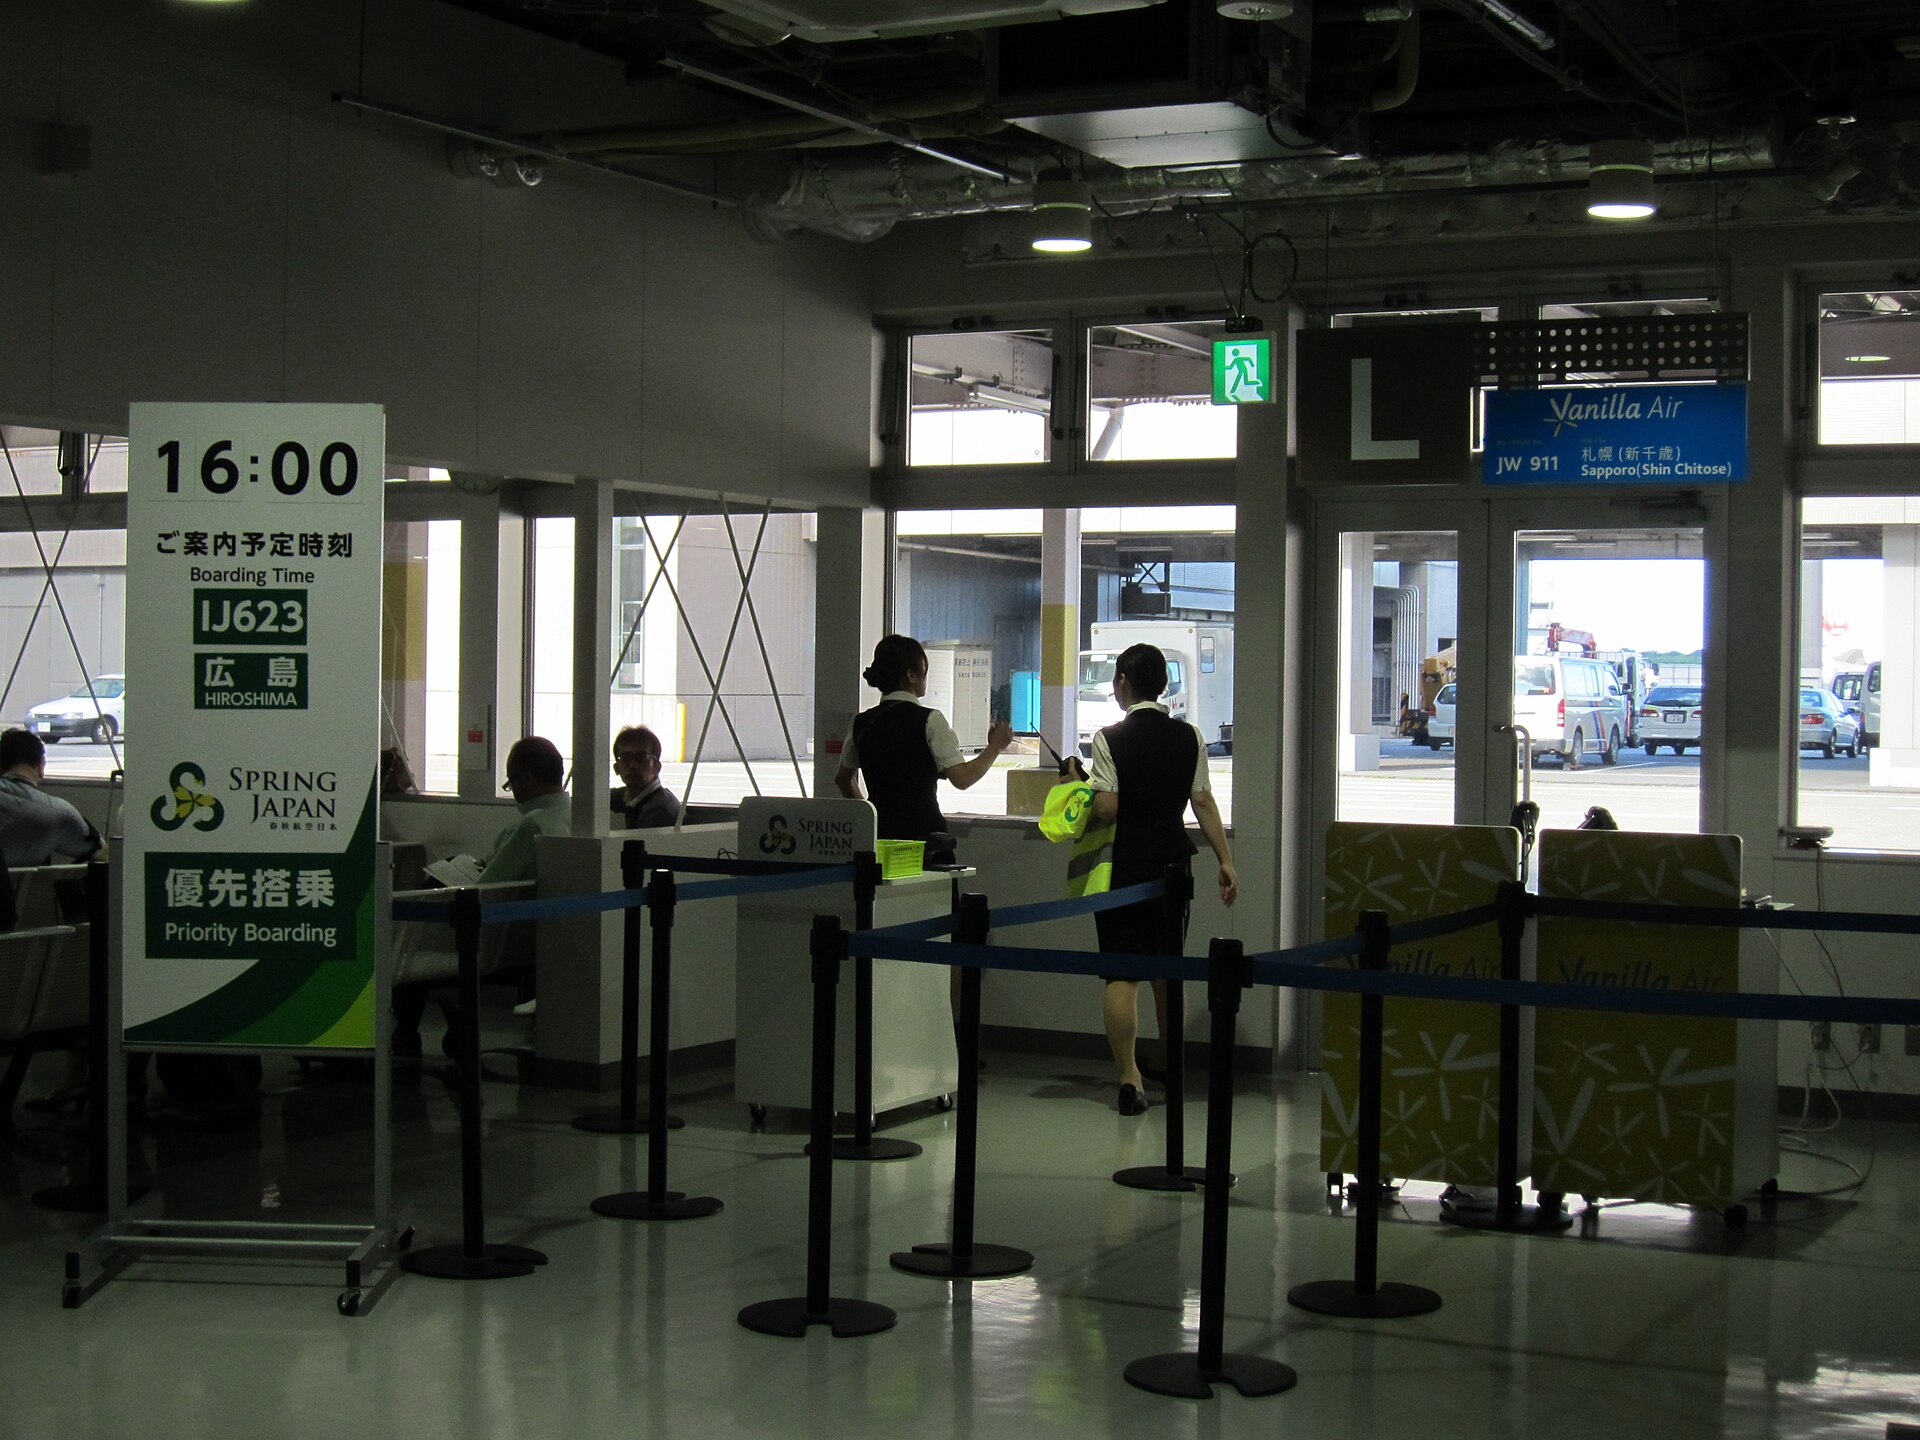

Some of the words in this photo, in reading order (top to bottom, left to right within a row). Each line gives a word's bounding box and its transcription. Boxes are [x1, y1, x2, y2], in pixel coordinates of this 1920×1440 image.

[1351, 358, 1420, 461] L
[1549, 392, 1641, 426] Vanilla
[1647, 396, 1683, 419] Air
[157, 440, 358, 496] 16:00
[1496, 456, 1522, 475] JW
[1530, 456, 1559, 471] 911
[1675, 462, 1732, 478] Chitose)
[156, 530, 353, 558] ご案内予定時刻
[190, 567, 267, 586] Boarding
[272, 568, 315, 584] Time
[201, 599, 305, 634] IJ623
[205, 692, 298, 707] HIROSHIMA
[229, 767, 337, 792] SPRING
[250, 794, 336, 824] JAPAN
[797, 818, 852, 834] SPRING
[809, 835, 853, 851] JAPAN
[165, 868, 336, 908] 優先搭乗
[165, 922, 238, 947] Priority
[244, 923, 337, 948] Boarding
